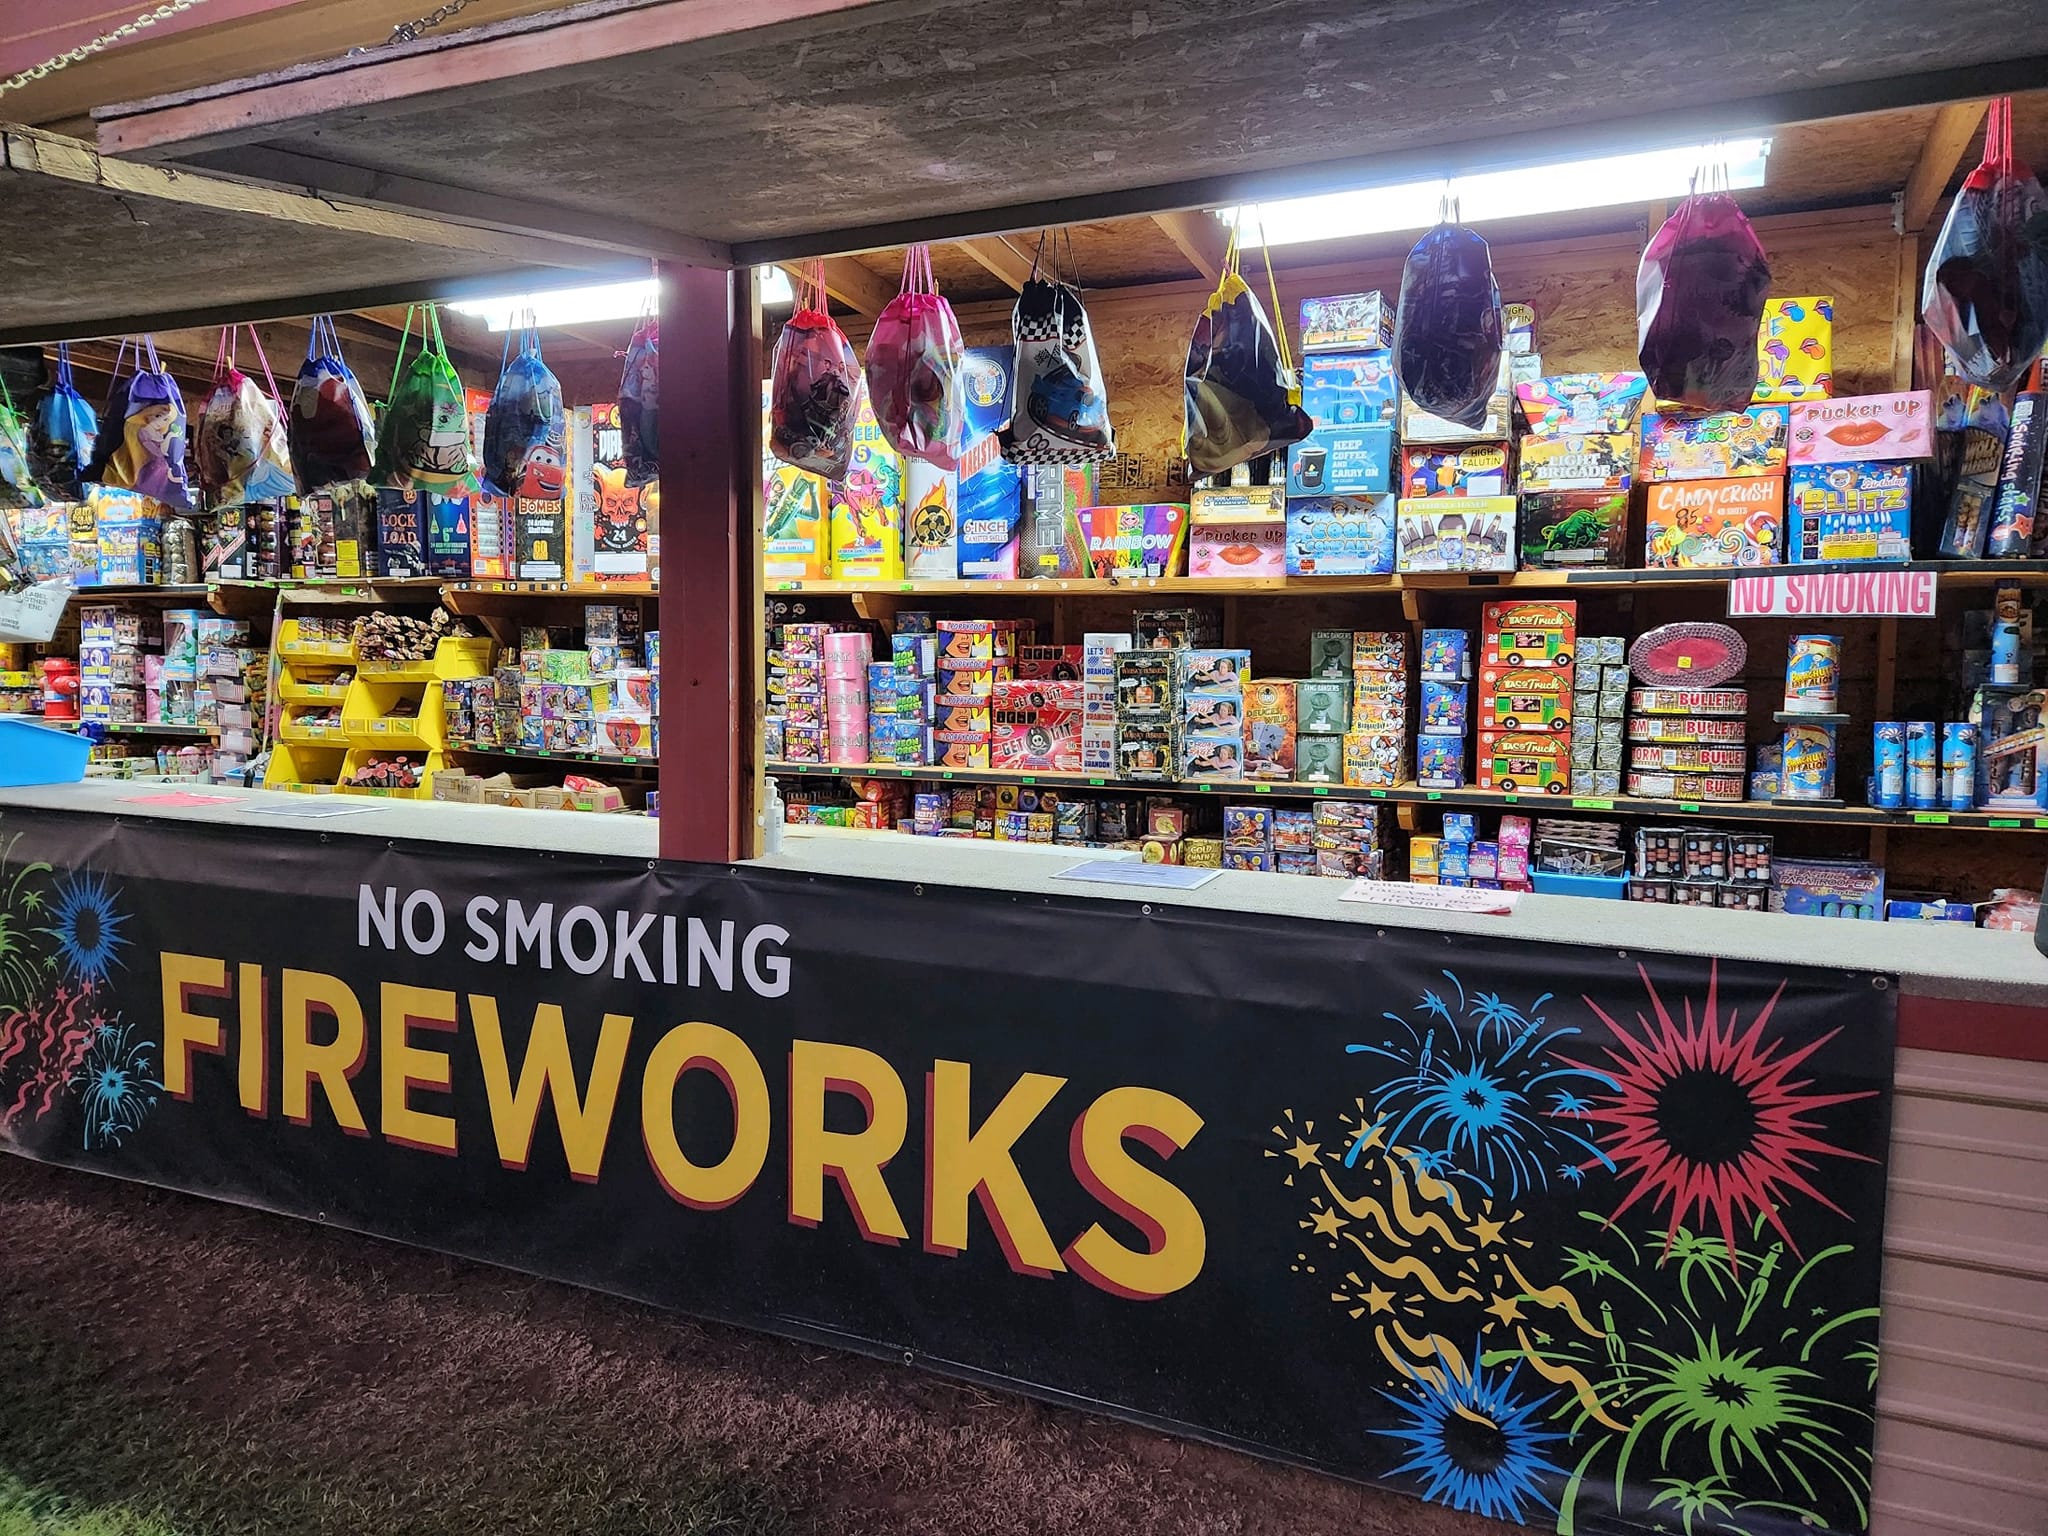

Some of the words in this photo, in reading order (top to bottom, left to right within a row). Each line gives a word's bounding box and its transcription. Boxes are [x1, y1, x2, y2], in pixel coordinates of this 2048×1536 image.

[1663, 415, 1755, 432] ARTISTIC
[1334, 440, 1363, 450] KEEP
[1333, 451, 1367, 460] COFFEE
[1470, 447, 1494, 457] HIGH
[1332, 461, 1347, 469] AND
[1462, 456, 1501, 468] FALUTIN
[1549, 453, 1601, 466] LIGHT
[1332, 468, 1363, 477] CARRY
[1365, 467, 1379, 477] ON
[1537, 465, 1611, 479] BRIGADE
[406, 491, 415, 500] 12
[1658, 486, 1718, 514] CANDY
[1719, 481, 1775, 504] CRUSH
[1801, 488, 1908, 515] BLITZ
[519, 499, 561, 514] BOMBS
[381, 513, 417, 528] LOCK
[613, 530, 627, 541] 24
[1311, 521, 1374, 540] COOL
[382, 531, 417, 544] LOAD
[1089, 534, 1175, 551] RAINBOW
[1733, 576, 1775, 614] NO
[1785, 571, 1932, 614] SMOKING
[1533, 614, 1564, 625] Truck
[1087, 647, 1104, 655] LET'S
[893, 658, 917, 667] OREST
[1528, 679, 1560, 690] Truck
[1087, 693, 1103, 701] LET'S
[1679, 692, 1731, 707] BULLET
[1264, 714, 1288, 725] WILD
[1686, 720, 1734, 734] BULLET
[1084, 740, 1100, 748] LET'S
[1101, 740, 1111, 748] GO
[1526, 741, 1558, 753] Truck
[1705, 780, 1740, 793] BULLE
[1190, 846, 1213, 855] GOLD
[1320, 865, 1350, 878] BOXING
[1779, 874, 1874, 890] PARATROOPER
[357, 884, 446, 955] NO
[464, 895, 791, 998] SMOKING
[160, 951, 1206, 1300] FIREWORKS
